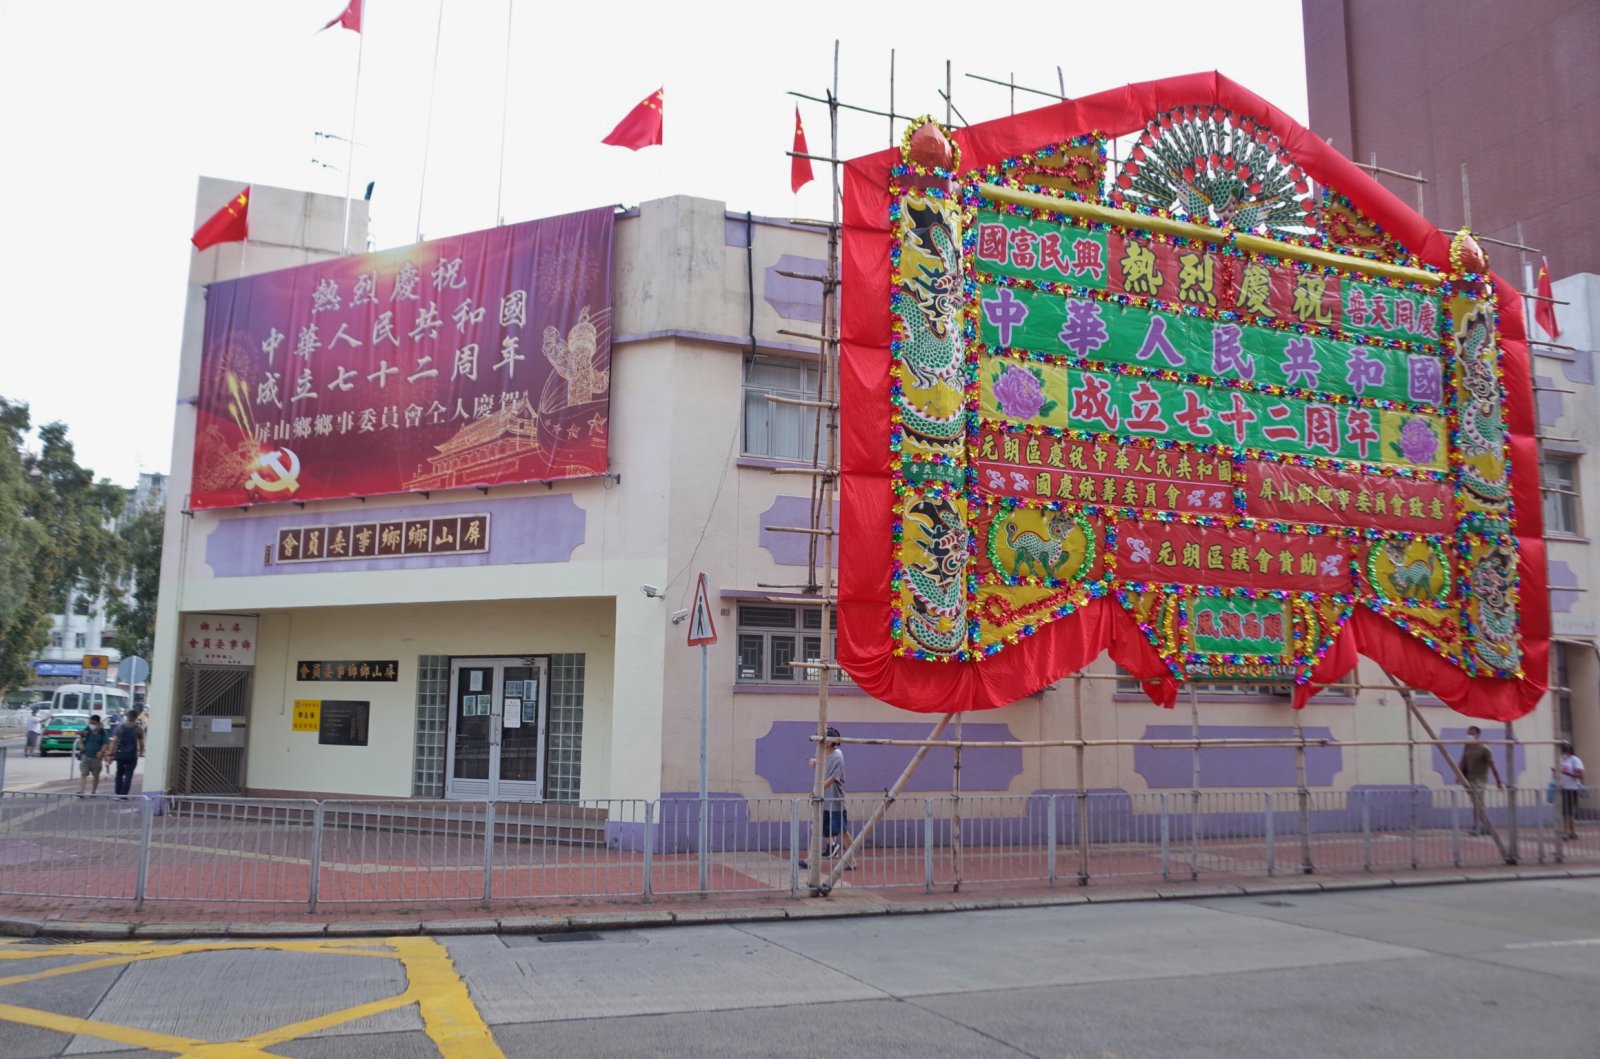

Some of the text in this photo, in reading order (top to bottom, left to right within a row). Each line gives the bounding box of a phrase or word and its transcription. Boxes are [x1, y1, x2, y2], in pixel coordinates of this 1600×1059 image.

[311, 257, 467, 315] 熱烈慶祝
[976, 223, 1105, 279] 國富民興
[1120, 240, 1334, 326] 熱烈慶祝
[262, 289, 528, 367] 中華人民共和國
[982, 288, 1444, 404] 中華人民共和國
[1344, 288, 1439, 340] 普天同慶
[256, 334, 526, 410] 成立七十二周年
[1069, 373, 1379, 458] 成立七十二周年
[978, 434, 1233, 483] 元朗區慶祝中華人民共和國
